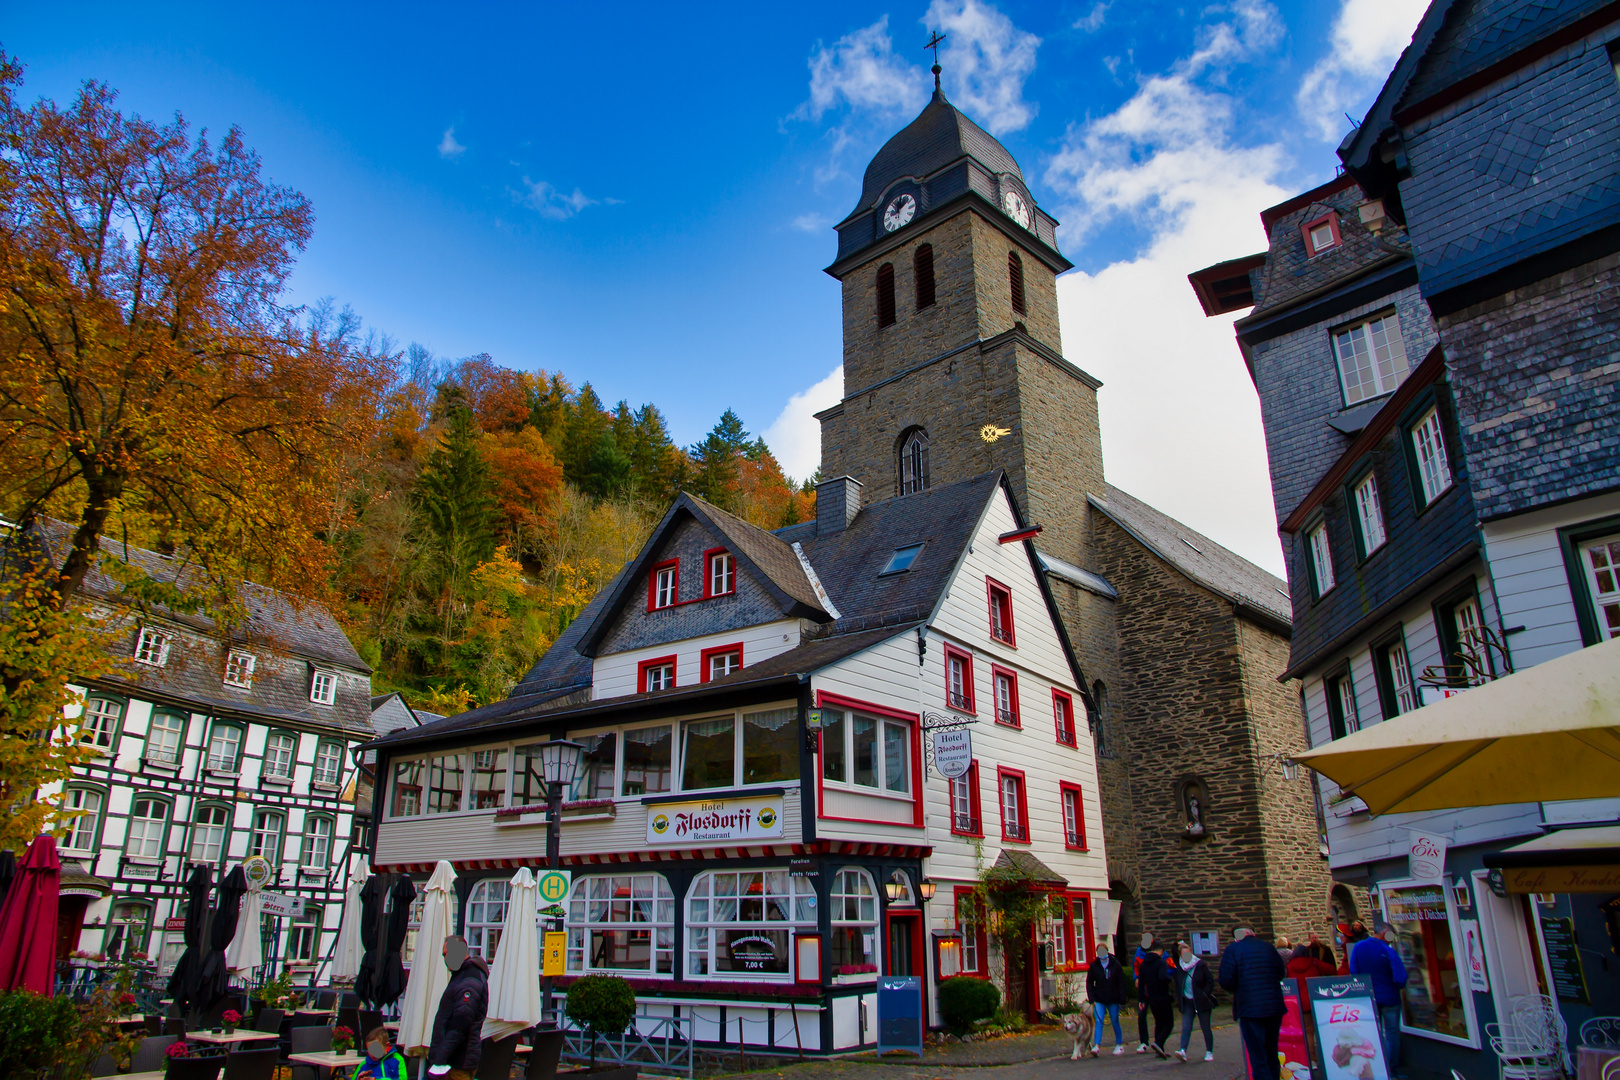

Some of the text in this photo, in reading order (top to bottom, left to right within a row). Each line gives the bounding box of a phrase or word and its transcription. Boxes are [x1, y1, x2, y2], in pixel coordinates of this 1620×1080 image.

[941, 733, 963, 743] Hotel
[938, 743, 967, 754] Flosdorff
[938, 754, 968, 762] Restaurant
[701, 802, 724, 811] Hotel
[675, 808, 751, 837] Flosdorff
[693, 832, 731, 840] Restaurant
[1411, 837, 1440, 858] Eis
[123, 866, 157, 876] Restaurant
[304, 876, 322, 885] Stern
[1563, 869, 1620, 886] Kondit
[263, 902, 285, 913] Stern
[1418, 909, 1424, 920] &
[1424, 908, 1447, 920] Dütchen
[745, 961, 764, 969] 7,00 €
[1329, 1004, 1360, 1024] Eis
